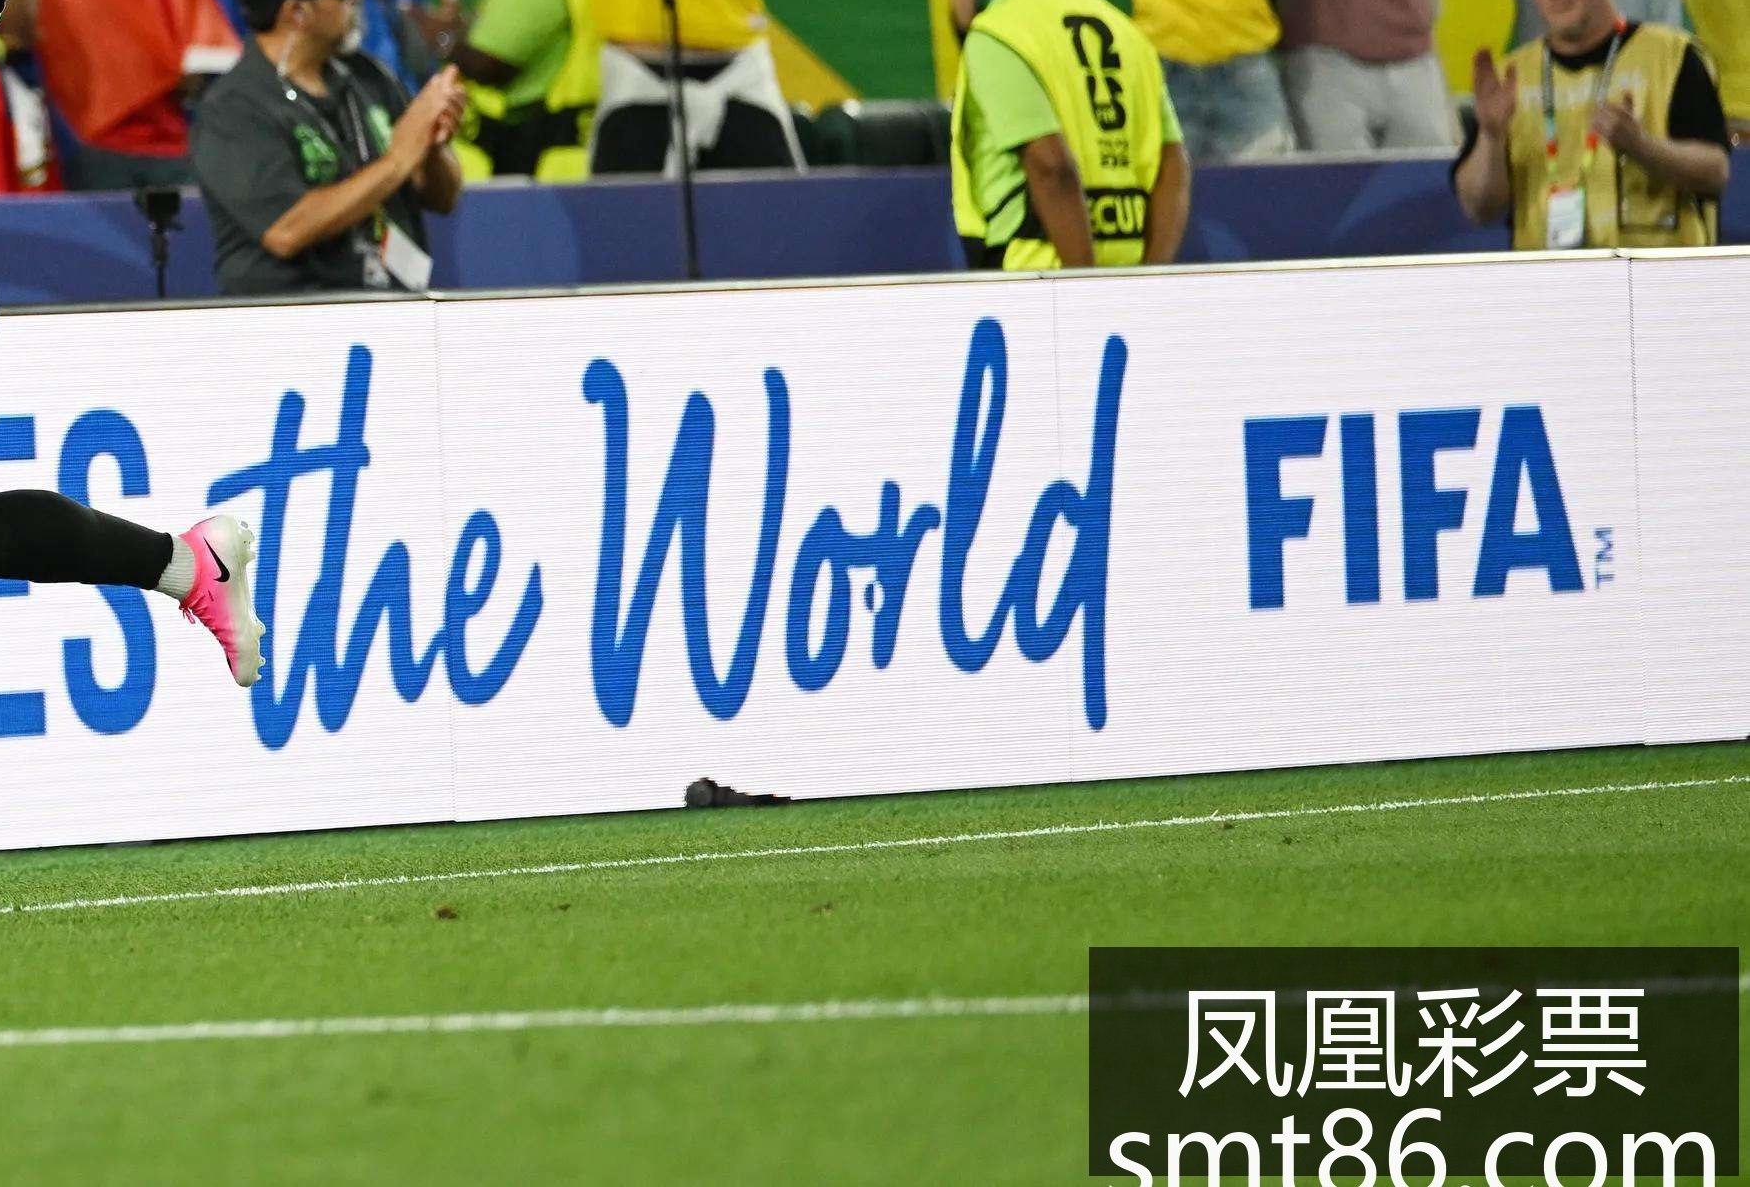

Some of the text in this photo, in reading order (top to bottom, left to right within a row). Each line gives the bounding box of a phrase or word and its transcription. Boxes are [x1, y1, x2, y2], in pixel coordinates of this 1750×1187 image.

[206, 344, 543, 750] the
[582, 317, 1130, 732] World
[1243, 404, 1585, 611] FIFA
